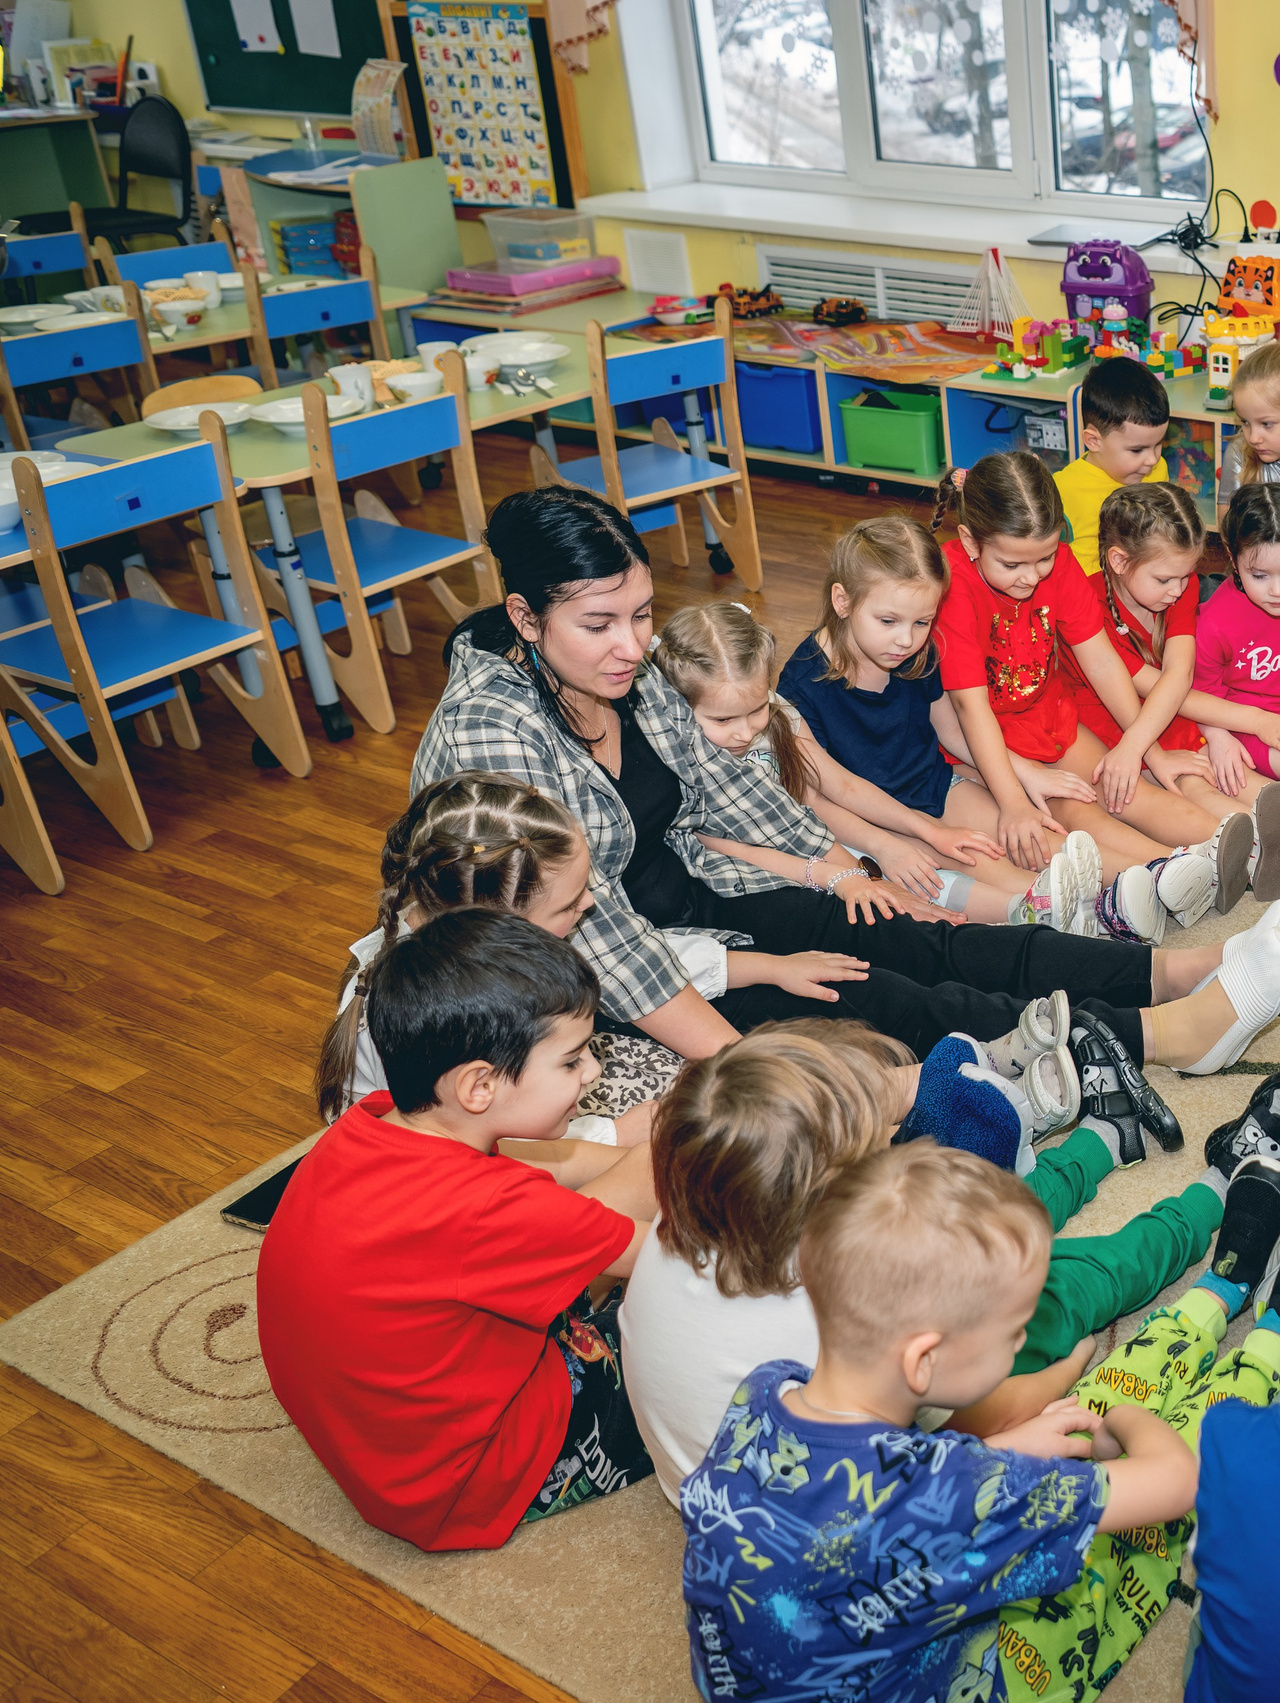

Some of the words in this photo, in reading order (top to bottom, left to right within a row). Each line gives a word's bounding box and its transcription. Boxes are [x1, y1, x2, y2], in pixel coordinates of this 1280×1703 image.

[414, 19, 424, 33] А
[437, 20, 447, 34] Б
[460, 20, 470, 34] В
[484, 20, 491, 34] Г
[507, 21, 518, 36] Д
[418, 46, 428, 60] Е
[464, 48, 476, 60] Ж
[489, 48, 498, 62] З
[510, 48, 522, 62] И
[446, 74, 456, 87] К
[492, 75, 504, 89] М
[514, 76, 527, 90] Н
[429, 98, 439, 114] О
[451, 100, 462, 114] П
[474, 101, 483, 114] Р
[496, 102, 507, 116] С
[520, 103, 530, 116] Т
[434, 125, 442, 139] У
[456, 127, 468, 140] Ф
[479, 128, 490, 141] Х
[500, 128, 513, 143] Ц
[524, 130, 536, 143] Ч
[504, 154, 518, 168] Ы
[464, 178, 474, 192] Э
[486, 179, 500, 193] Ю
[510, 180, 522, 194] Я
[1110, 1540, 1130, 1570] MY
[998, 1620, 1051, 1697] URBAN
